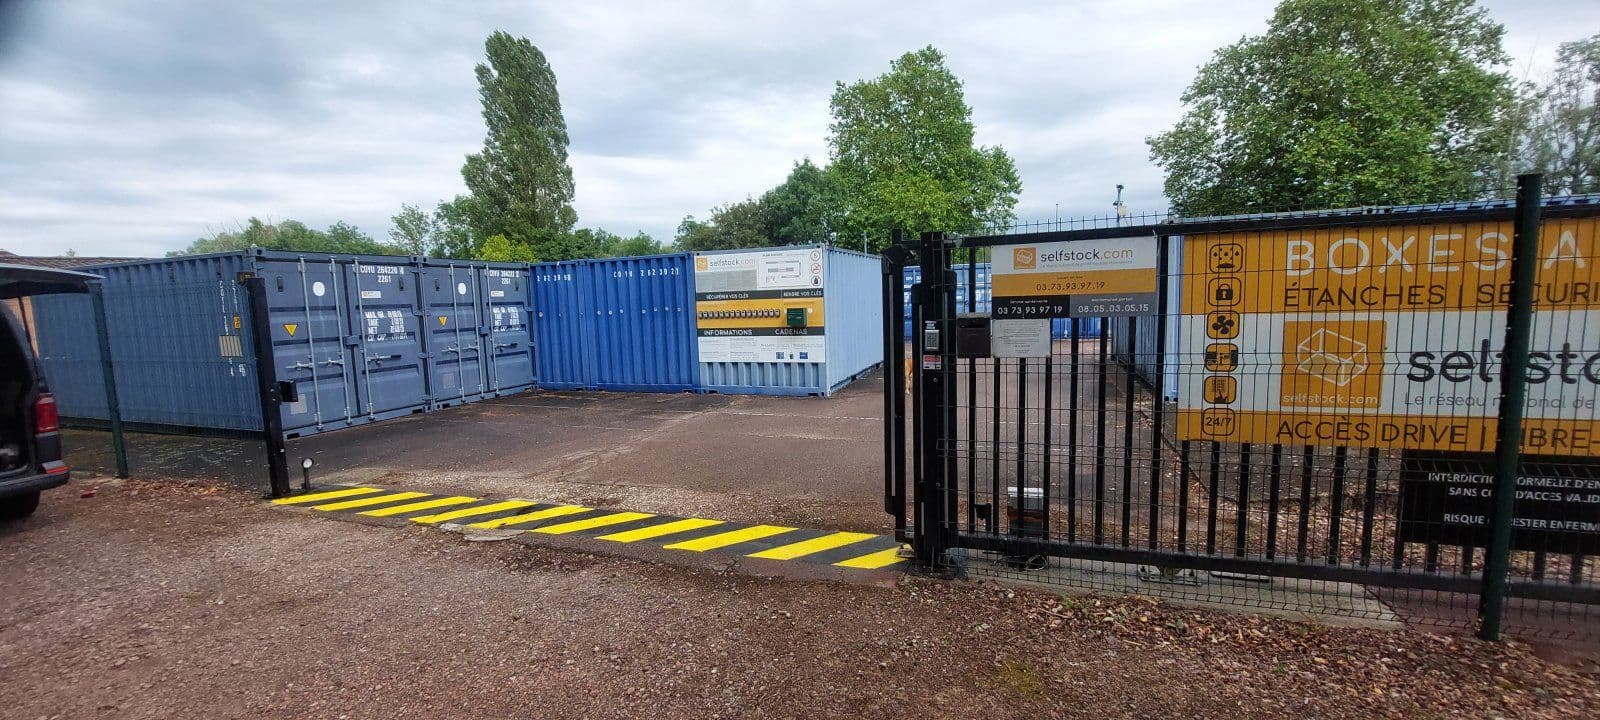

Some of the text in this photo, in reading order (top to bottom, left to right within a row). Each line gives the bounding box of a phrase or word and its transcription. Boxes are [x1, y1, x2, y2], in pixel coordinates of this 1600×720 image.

[1040, 248, 1133, 263] selfstock.com
[1286, 230, 1585, 276] BOXES A
[1036, 281, 1105, 291] 03.73.93.97.19
[1285, 281, 1445, 307] ÉTANCHES
[997, 305, 1063, 315] 03 73 93 97 19
[1407, 338, 1600, 385] selst
[1404, 391, 1424, 406] Le
[1429, 391, 1486, 407] réseau
[1572, 395, 1595, 409] de
[1204, 416, 1232, 427] 24/7
[1275, 415, 1370, 441] ACCÈS
[1381, 423, 1468, 445] DRIVE
[1428, 472, 1495, 484] INTERDICTI
[1516, 476, 1572, 488] ORMELLE
[1448, 486, 1478, 497] SANS
[1443, 513, 1486, 526] RISQUE
[1511, 517, 1547, 529] ESTER
